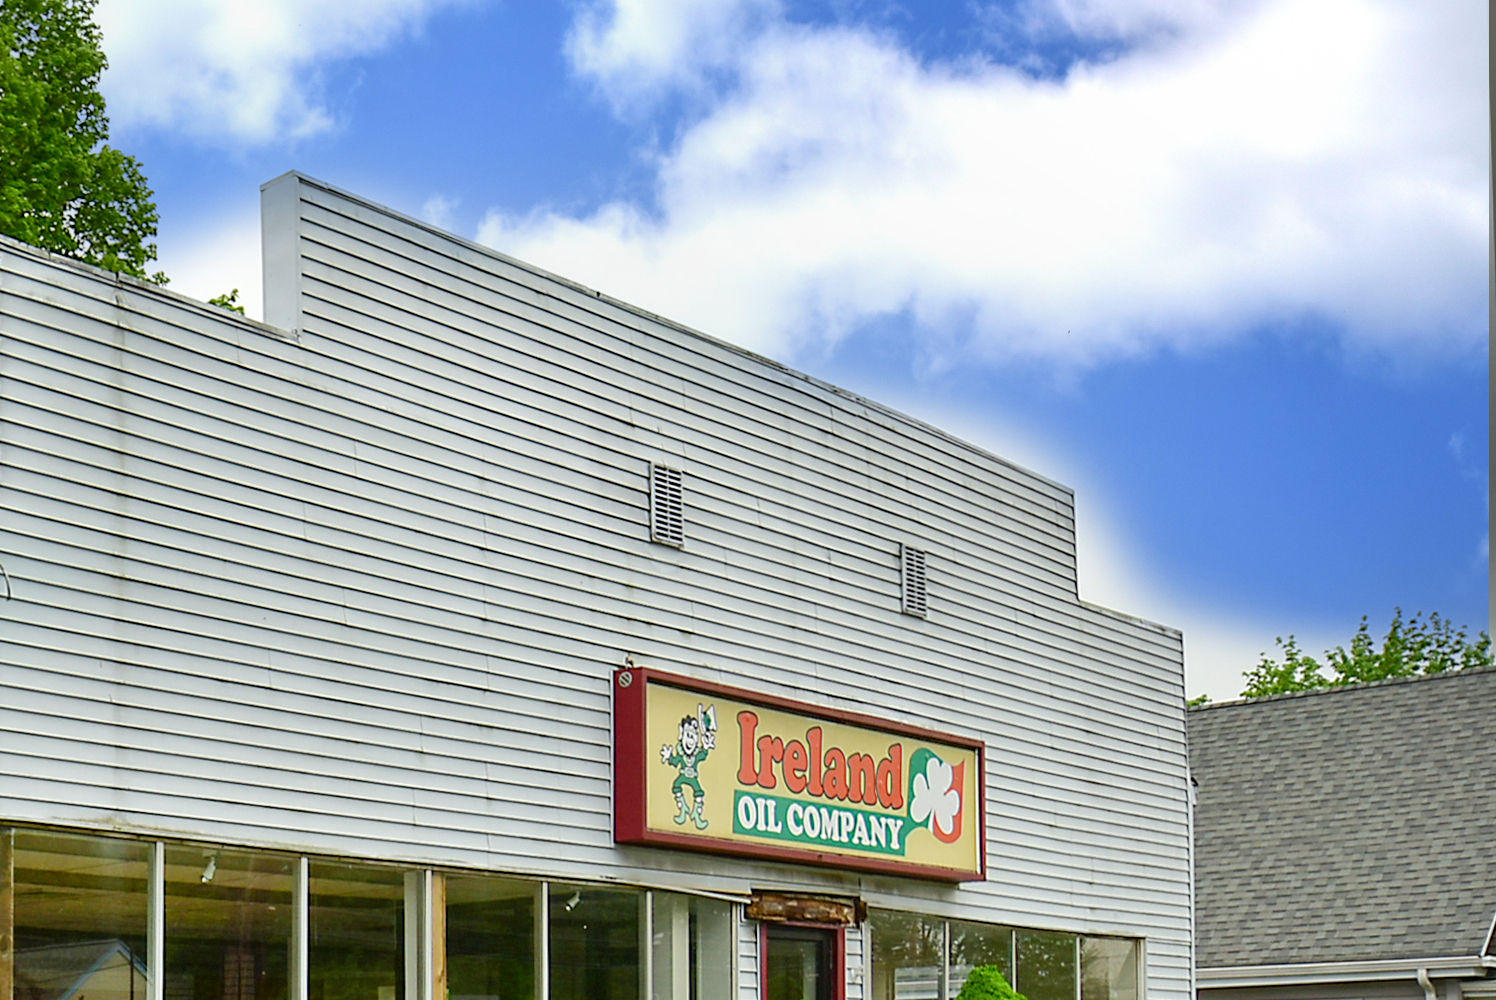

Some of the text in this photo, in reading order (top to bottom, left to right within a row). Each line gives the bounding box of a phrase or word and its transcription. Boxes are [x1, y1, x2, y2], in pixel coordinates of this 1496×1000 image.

[736, 710, 904, 809] Ireland
[737, 795, 904, 850] OIL COMPANY
